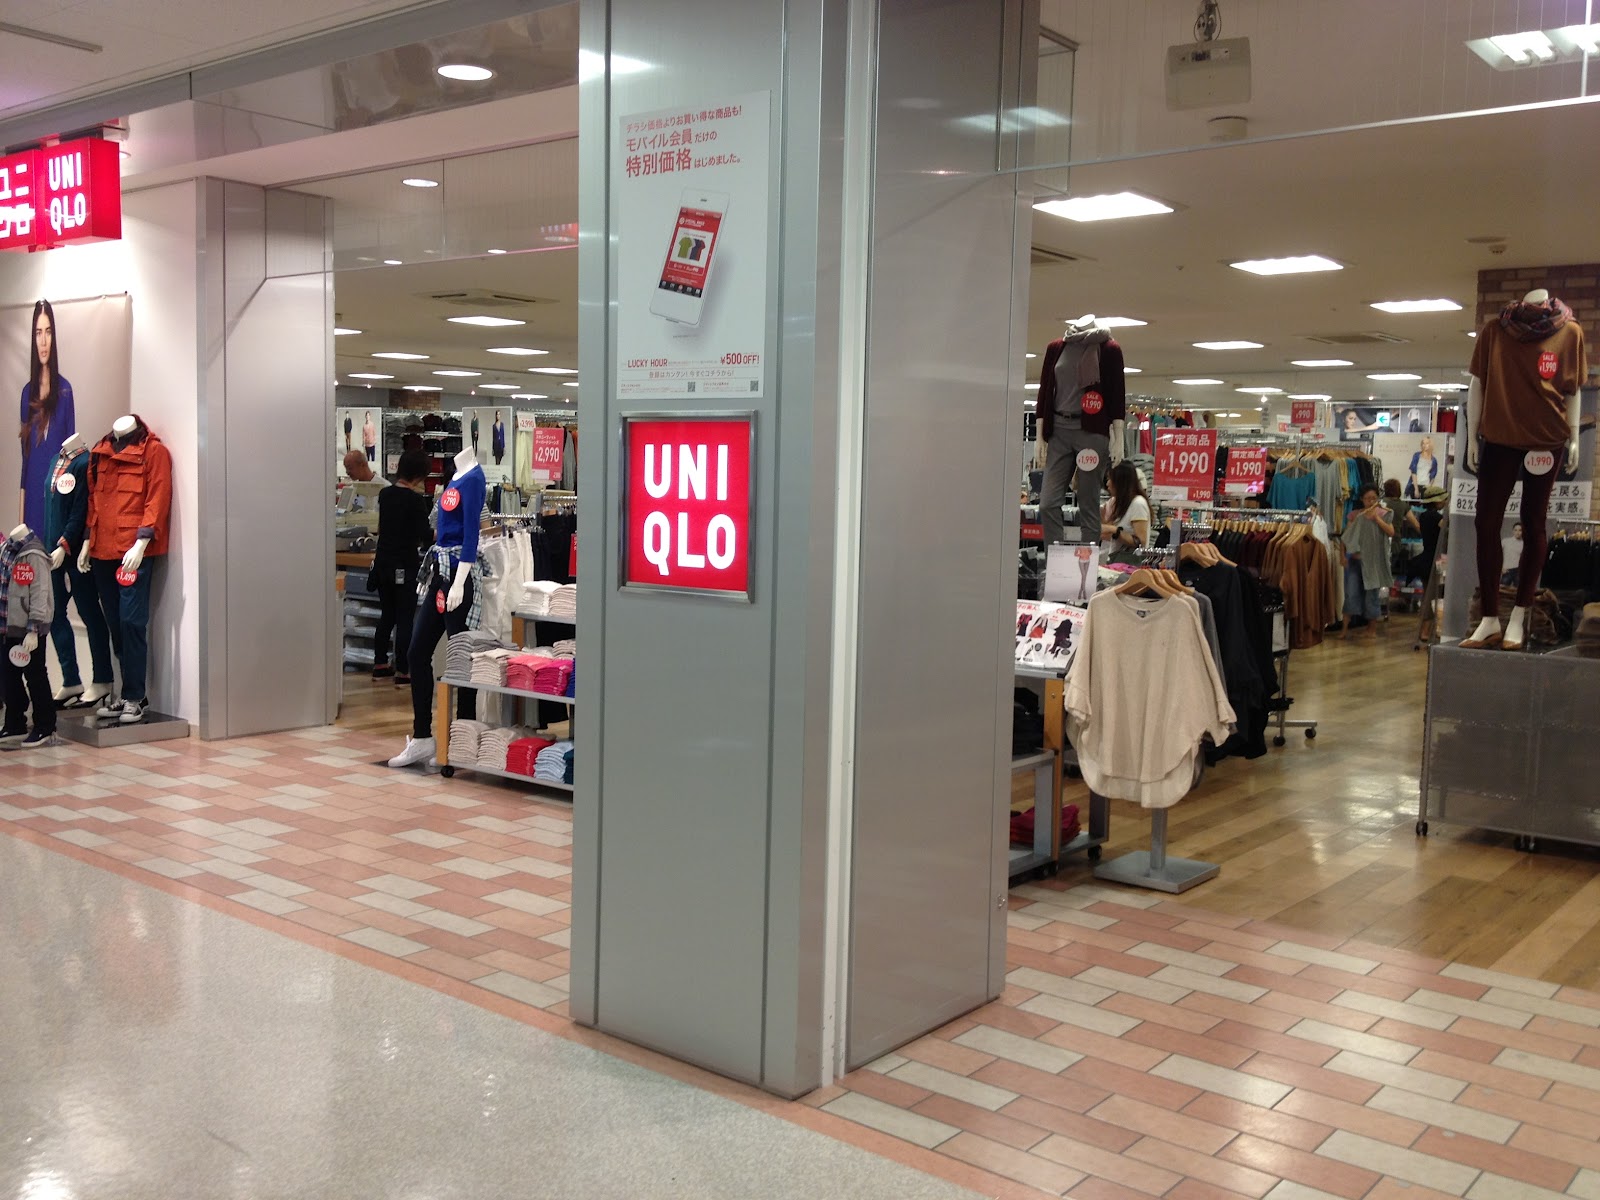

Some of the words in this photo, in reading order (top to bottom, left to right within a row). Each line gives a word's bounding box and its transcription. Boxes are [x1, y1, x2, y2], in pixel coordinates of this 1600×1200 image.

[49, 152, 82, 191] UNI
[50, 192, 86, 236] QLO
[627, 358, 648, 368] LUCKY
[650, 358, 668, 367] HOUR
[720, 352, 742, 365] ¥500
[743, 354, 760, 365] OFF!
[535, 446, 560, 464] ¥2,990
[1160, 451, 1209, 476] ¥1,990
[1230, 462, 1262, 476] ¥1,990
[643, 443, 729, 500] UNI
[643, 511, 736, 576] QLO
